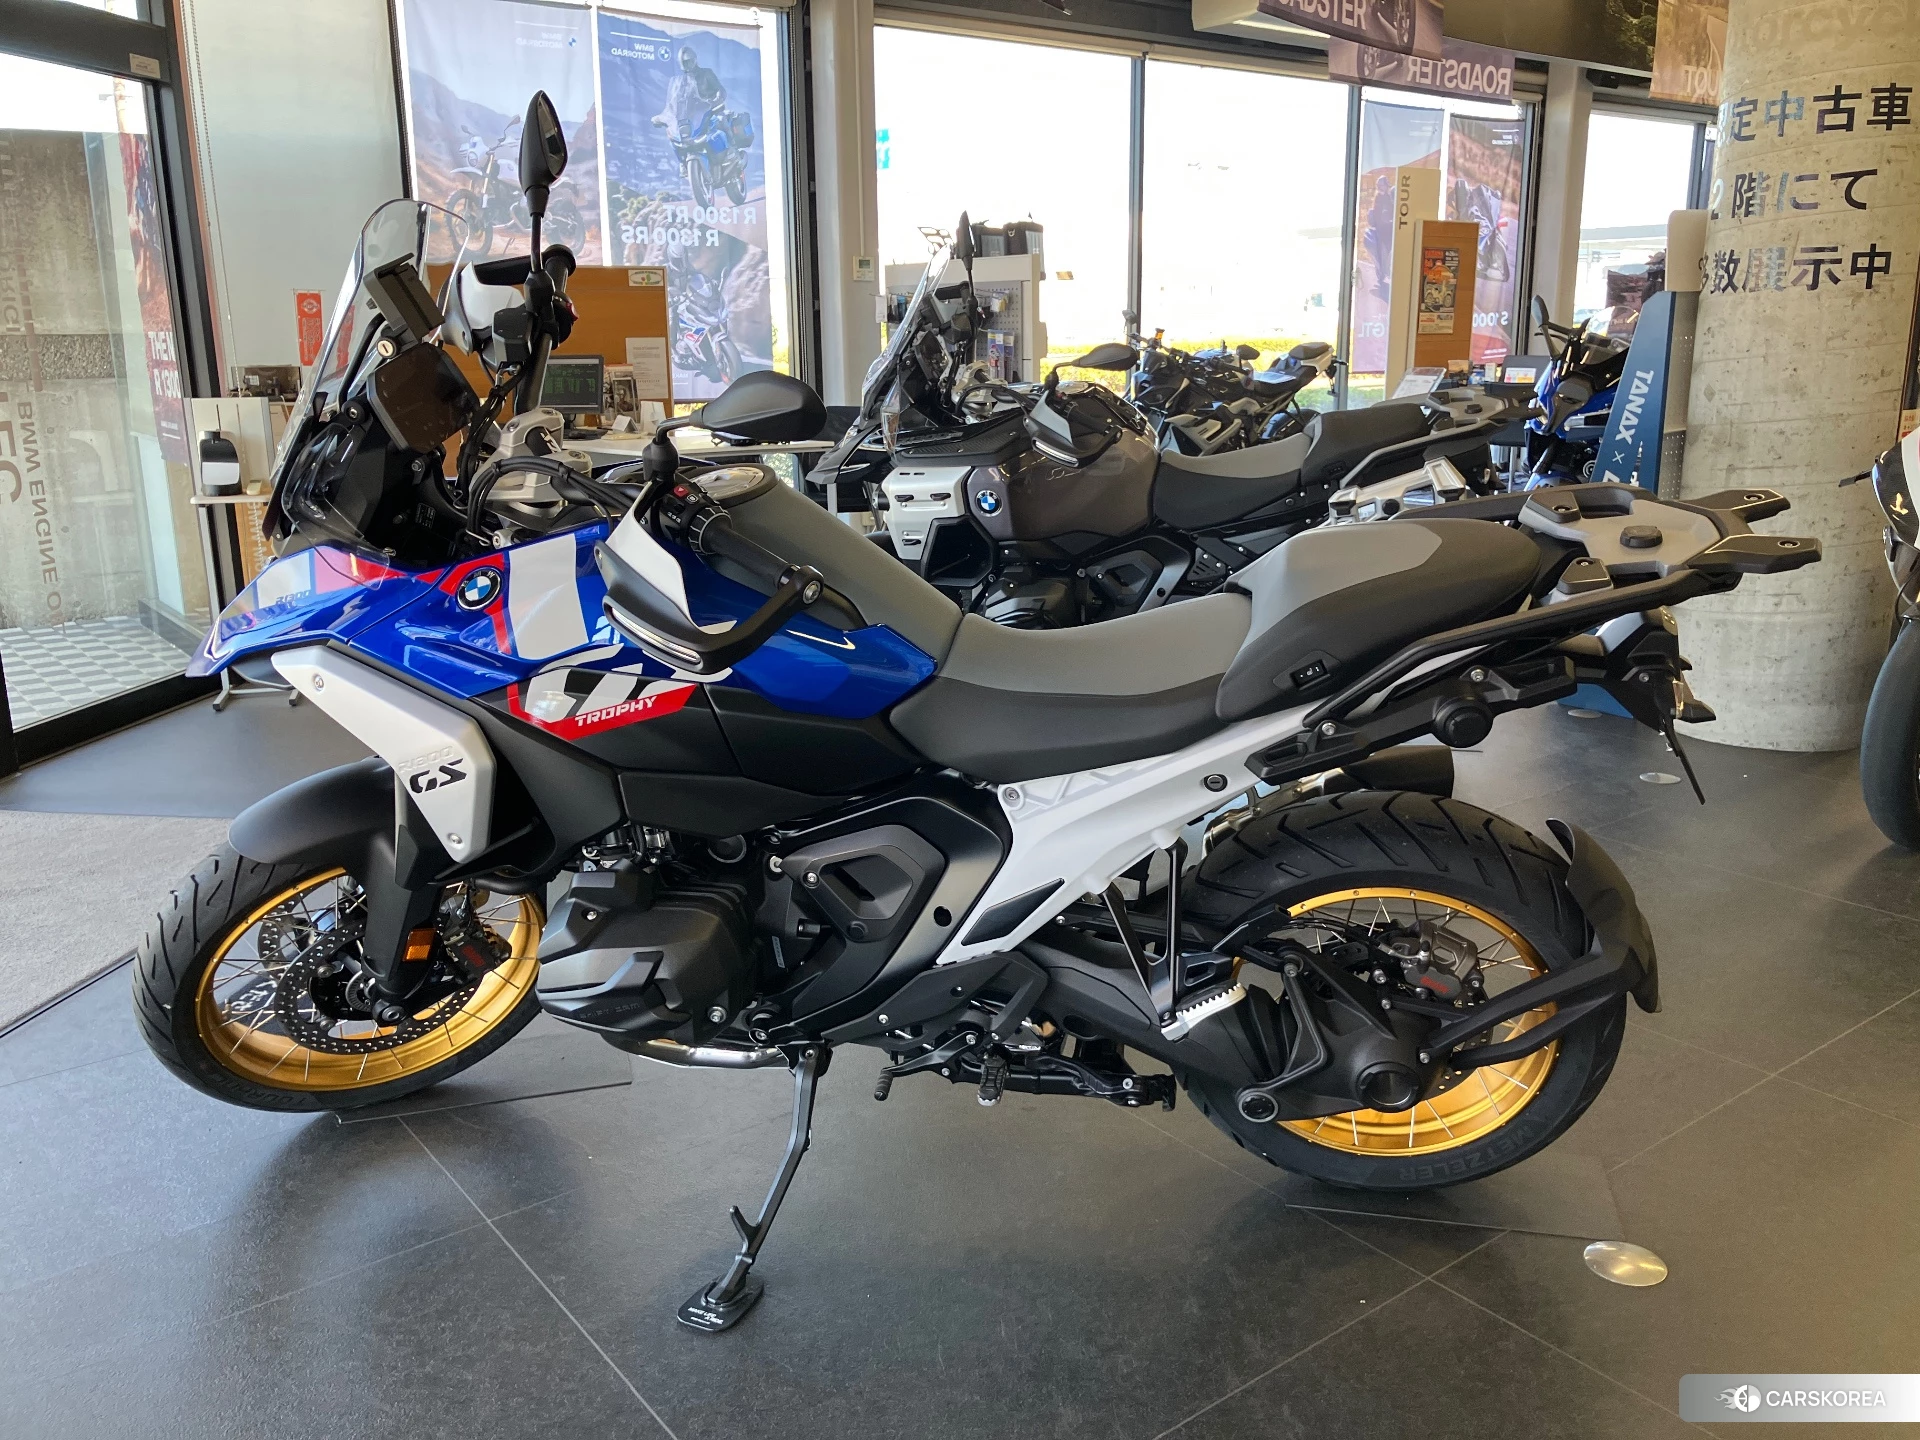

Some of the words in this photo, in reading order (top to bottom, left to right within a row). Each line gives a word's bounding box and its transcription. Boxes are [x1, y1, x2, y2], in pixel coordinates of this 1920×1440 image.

[1279, 0, 1367, 30] DSTER
[1399, 175, 1411, 230] TOUR
[1615, 370, 1654, 444] TANAX
[575, 696, 658, 727] TROPHY
[409, 757, 467, 794] GS
[1398, 1125, 1535, 1183] METZELER
